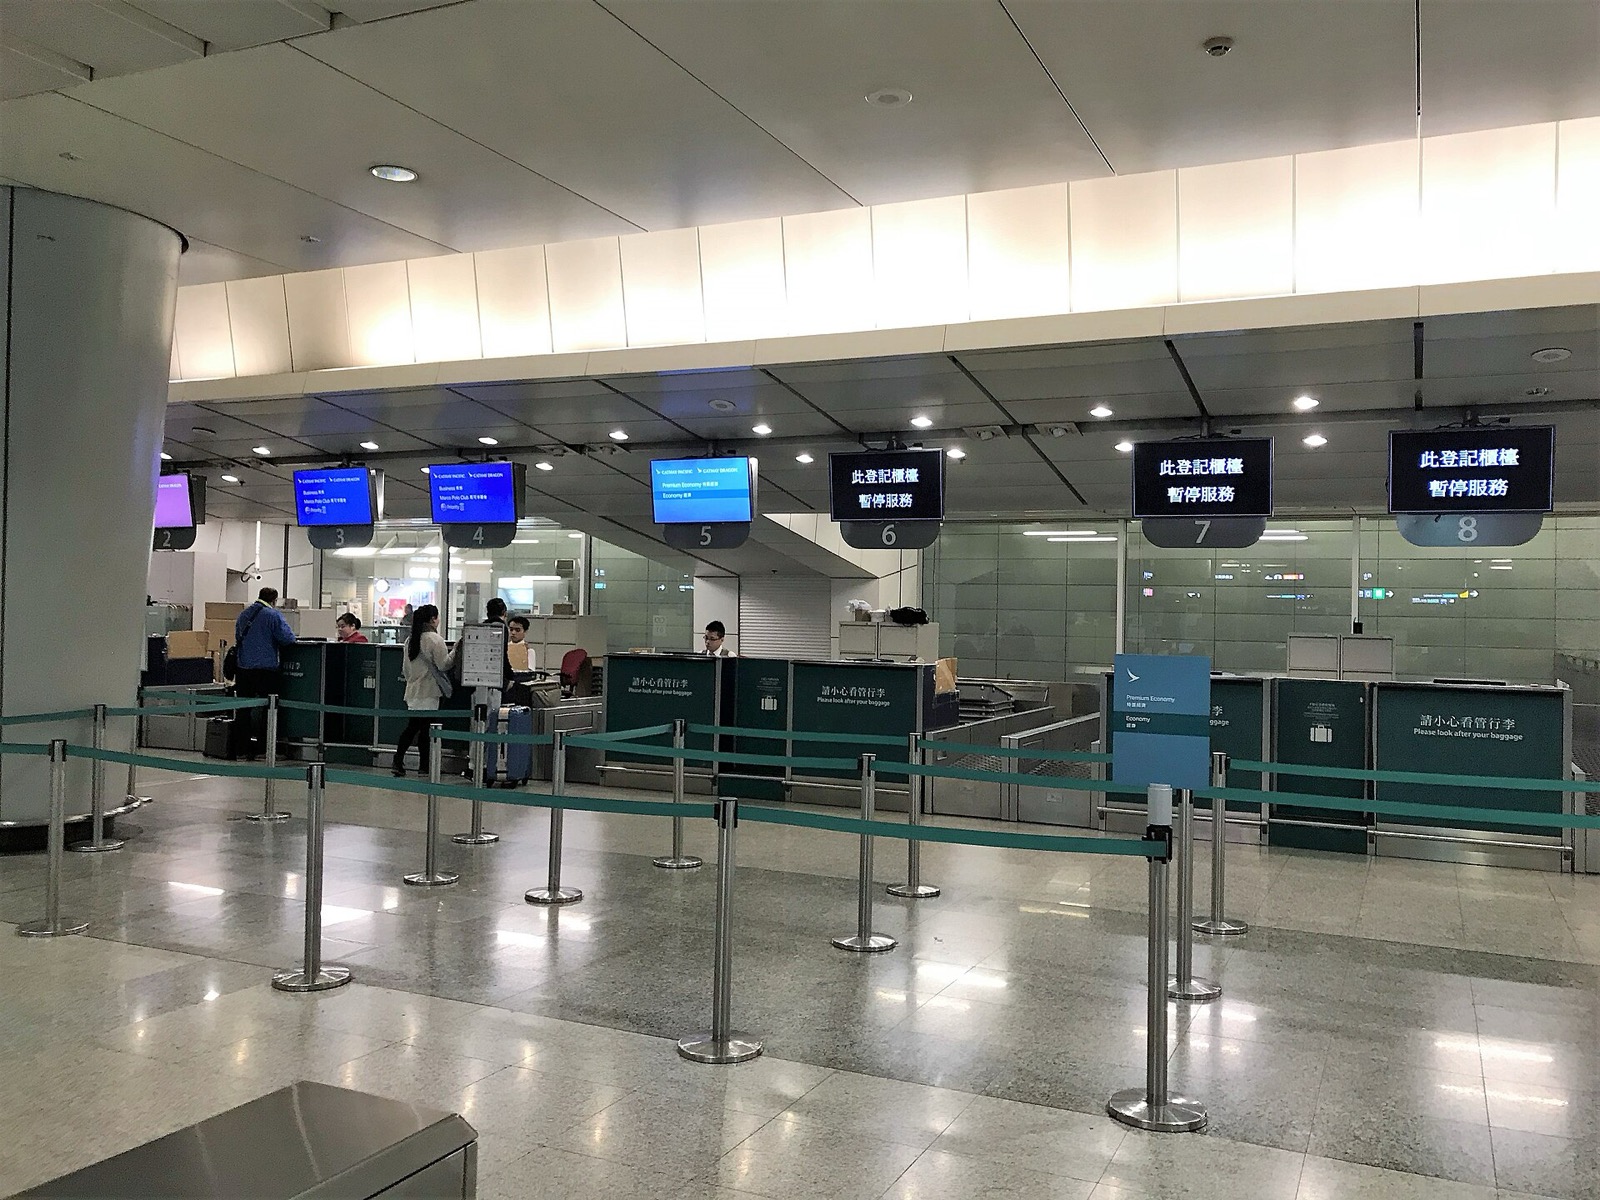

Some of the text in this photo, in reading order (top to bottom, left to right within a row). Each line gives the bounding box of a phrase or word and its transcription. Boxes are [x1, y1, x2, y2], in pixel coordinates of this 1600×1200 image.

[1159, 457, 1244, 476] 此登記櫃檯
[1420, 447, 1520, 468] 此登記櫃檯
[1167, 485, 1235, 503] 暫停服務
[1429, 478, 1509, 497] 暫停服務
[858, 493, 913, 508] 暫停服務
[336, 528, 344, 546] 3
[473, 526, 484, 545] 4
[700, 526, 712, 546] 5
[882, 524, 897, 546] 6
[1194, 520, 1212, 544] 7
[1457, 516, 1478, 542] 8
[163, 530, 171, 547] 2
[868, 699, 890, 707] baggage
[1150, 695, 1175, 703] Economy
[1125, 715, 1151, 723] Economy
[1209, 719, 1230, 727] ggage
[1420, 714, 1515, 730] 請小心看管行李
[1413, 727, 1436, 736] Please
[1437, 729, 1453, 737] look
[1454, 730, 1471, 738] after
[1491, 732, 1523, 742] baggage
